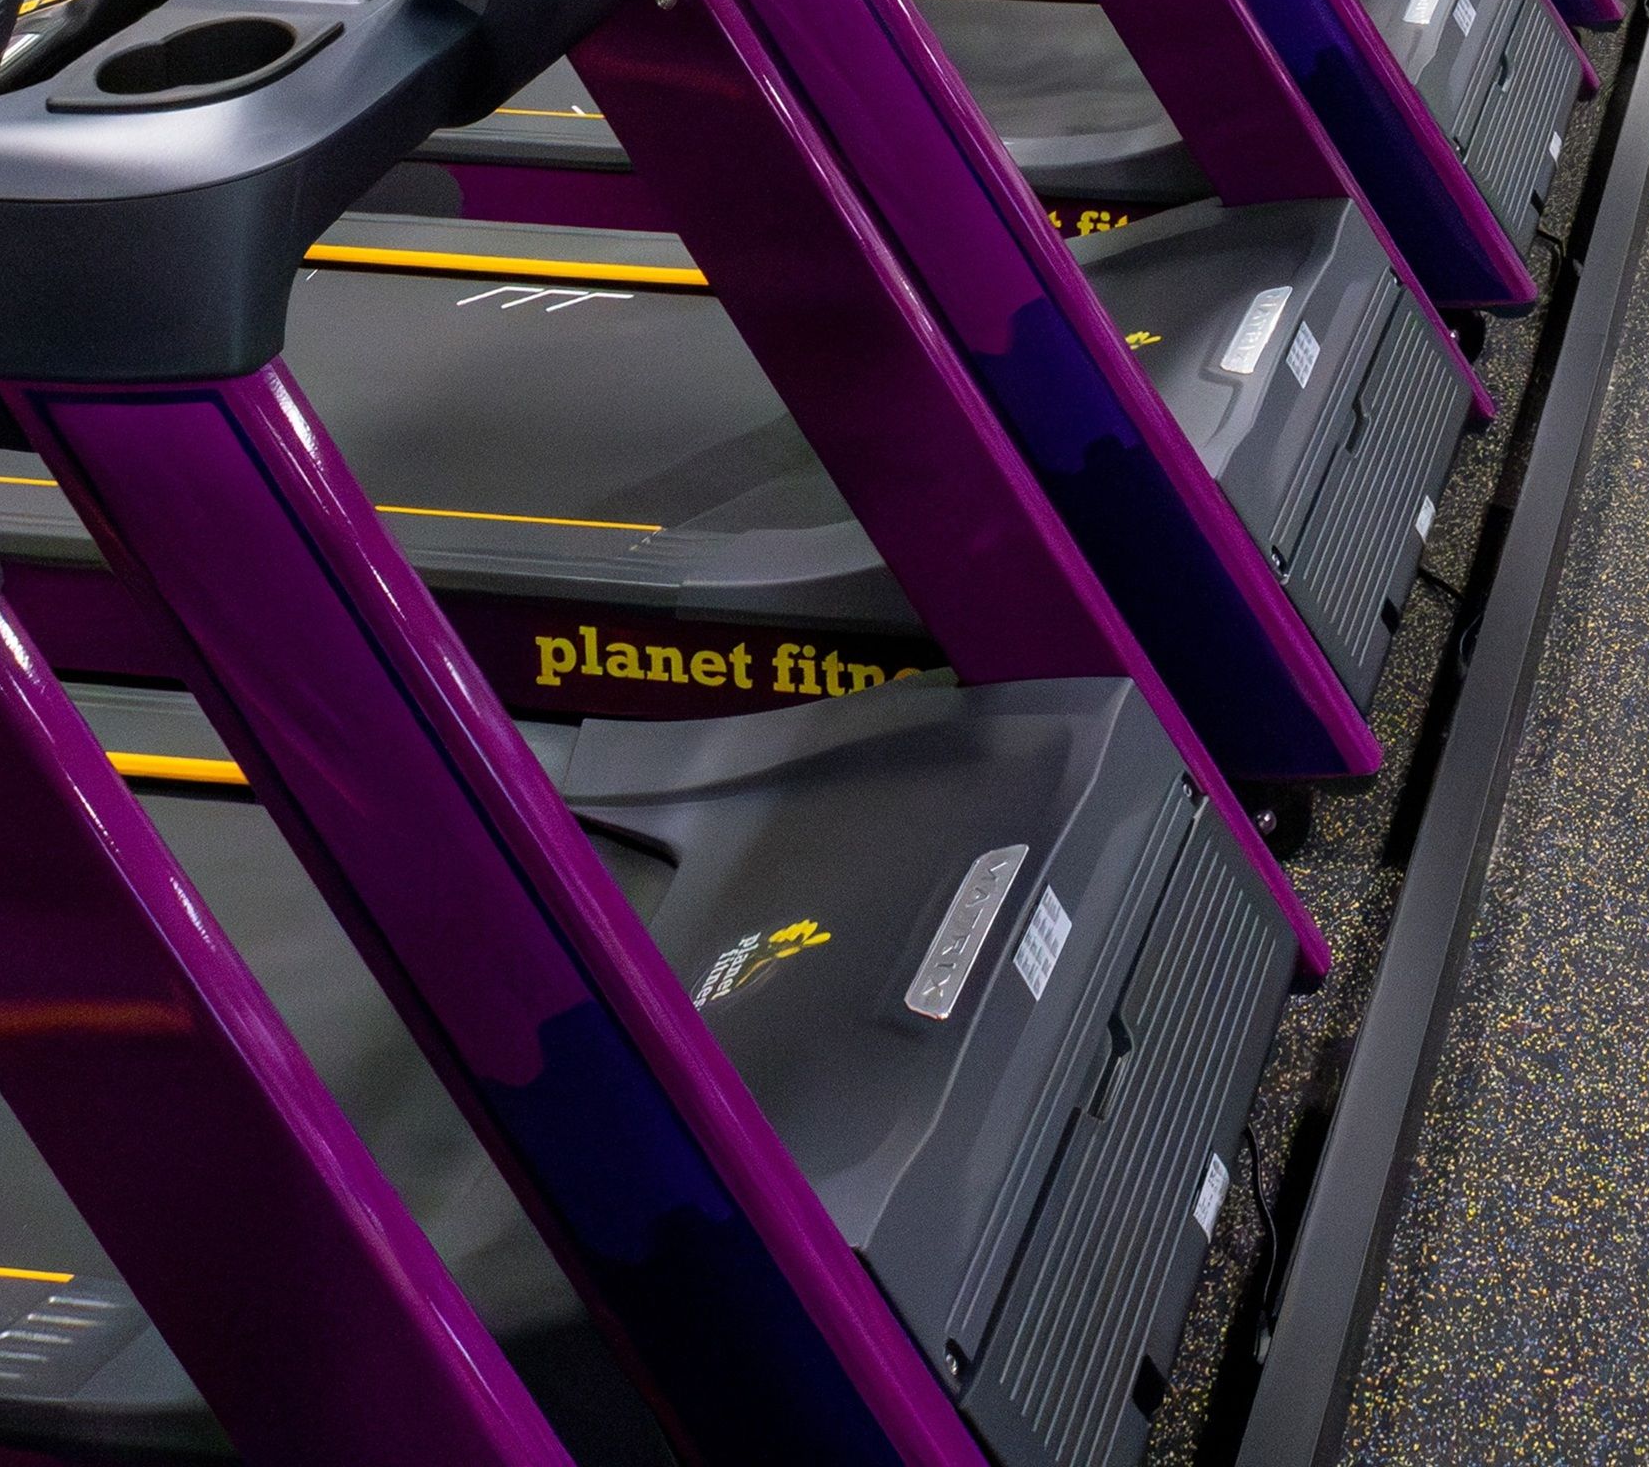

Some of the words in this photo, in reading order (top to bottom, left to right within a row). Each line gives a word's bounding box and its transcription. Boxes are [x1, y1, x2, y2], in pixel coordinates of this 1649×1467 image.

[536, 627, 754, 692] planet
[773, 645, 926, 697] fitn
[711, 931, 762, 1001] planet
